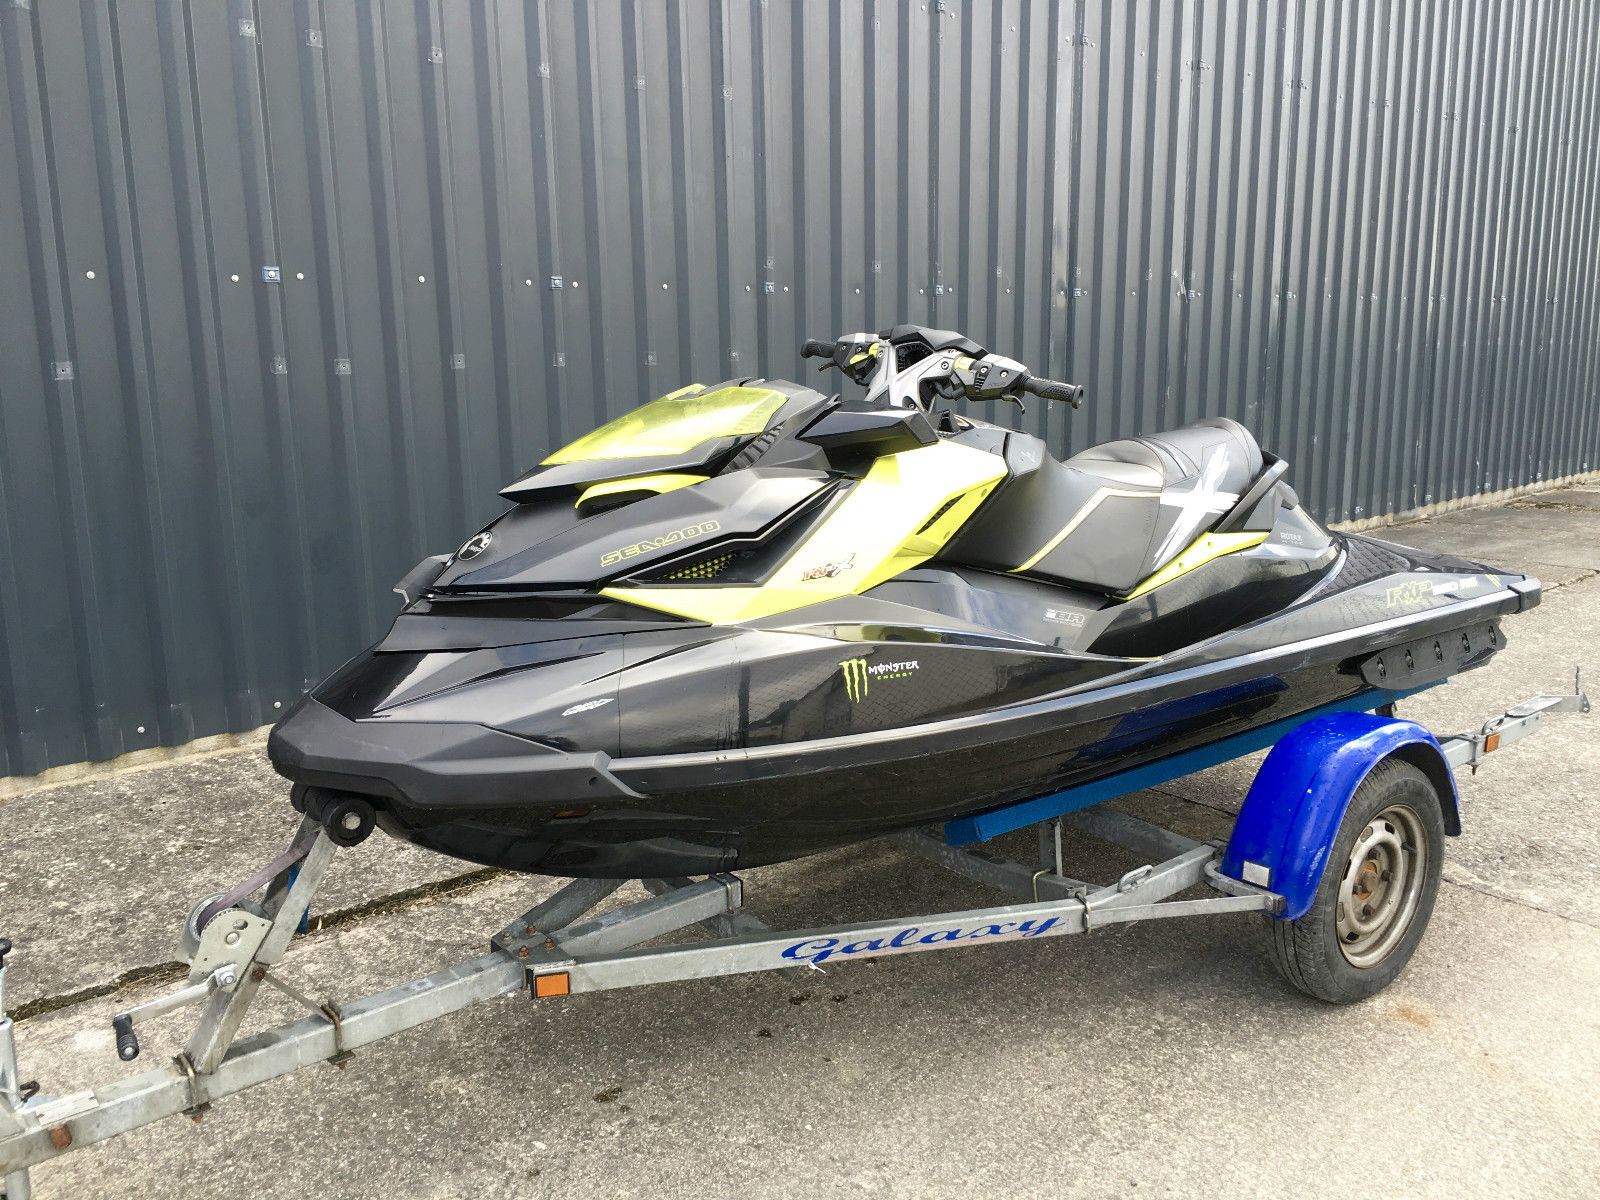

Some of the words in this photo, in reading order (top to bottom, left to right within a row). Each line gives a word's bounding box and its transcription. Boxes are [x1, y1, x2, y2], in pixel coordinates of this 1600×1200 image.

[1386, 580, 1433, 608] RXP
[868, 660, 919, 675] MONSTER
[877, 671, 913, 681] ENERGY
[781, 916, 1066, 964] Galaxy
